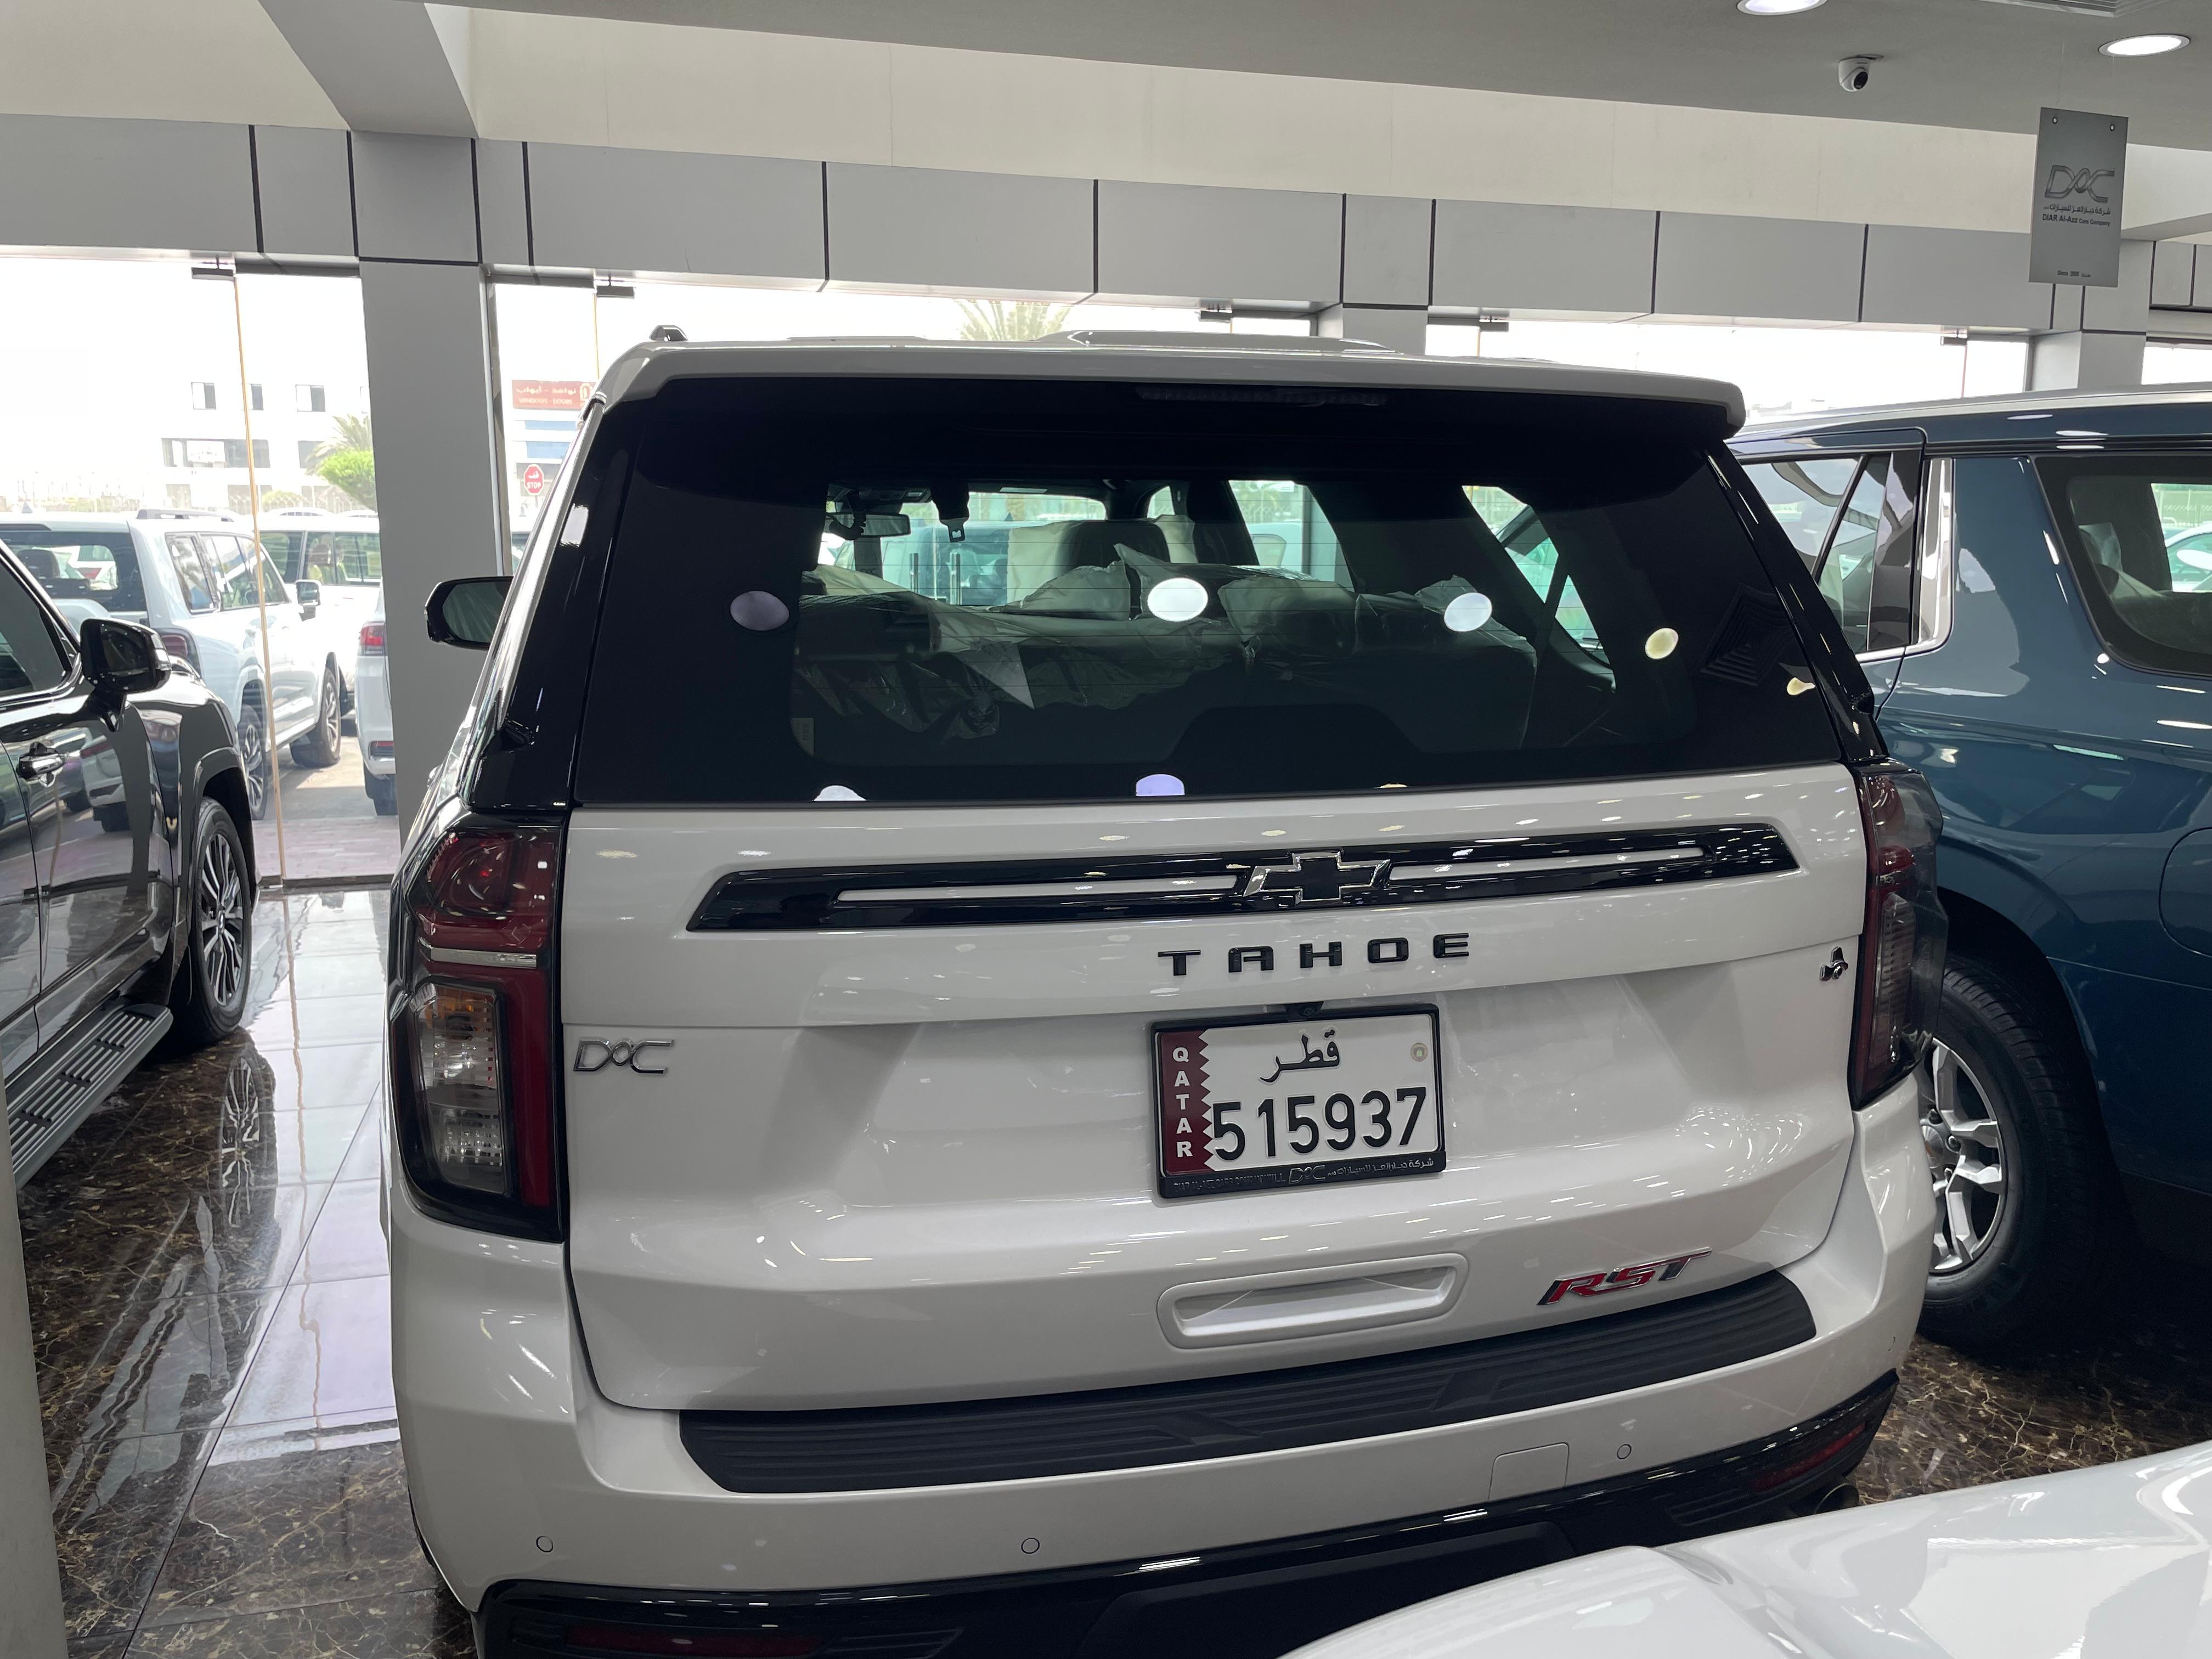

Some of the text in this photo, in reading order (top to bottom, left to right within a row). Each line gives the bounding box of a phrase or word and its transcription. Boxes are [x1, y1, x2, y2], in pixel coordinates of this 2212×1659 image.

[2042, 213, 2058, 222] DIAR
[1157, 932, 1470, 976] TAHOE
[1259, 1028, 1341, 1084] قطر
[1172, 1046, 1193, 1158] QATAR
[1211, 1086, 1427, 1162] 515937
[1409, 1157, 1434, 1169] شركة
[1537, 1246, 1713, 1306] RST
